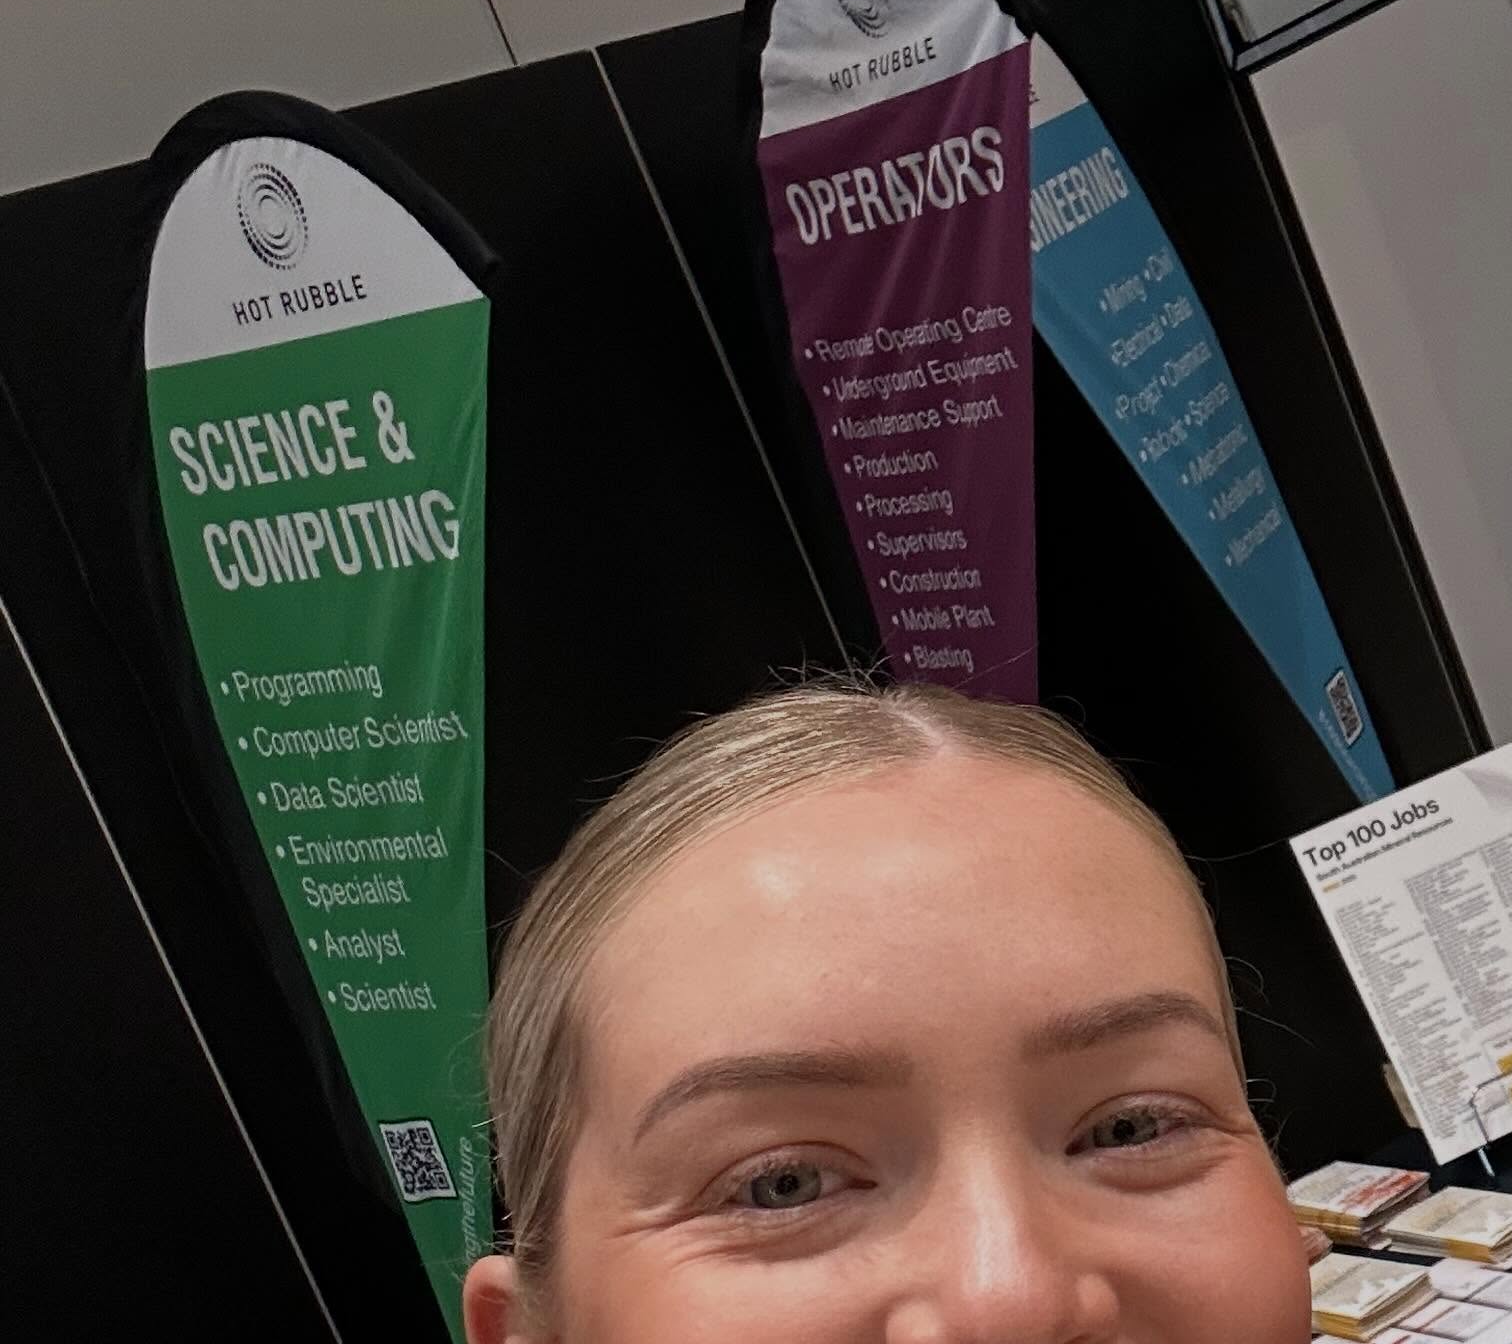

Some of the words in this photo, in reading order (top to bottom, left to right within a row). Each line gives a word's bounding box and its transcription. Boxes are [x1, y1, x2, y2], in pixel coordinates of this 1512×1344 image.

[829, 61, 863, 94] HOT
[867, 36, 938, 80] RUBBLE
[784, 125, 1005, 247] OPERATORS
[232, 295, 274, 326] HOT
[279, 274, 369, 317] RUBBLE
[875, 317, 964, 353] Operating
[962, 304, 1013, 334] Centre
[831, 363, 928, 403] Underground
[927, 346, 1019, 388] Equipment
[839, 406, 942, 442] Maintenance
[942, 394, 1004, 429] Support
[168, 399, 367, 496] SCIENCE
[372, 390, 416, 464] &
[852, 449, 939, 480] Production
[864, 486, 954, 518] Processing
[202, 488, 460, 593] COMPUTING
[875, 526, 968, 560] Supervisors
[888, 563, 982, 595] Construction
[900, 607, 952, 632] Mobile
[952, 604, 996, 629] Plant
[911, 644, 975, 674] Blasting
[231, 659, 384, 707] Programming
[251, 721, 361, 760] Computer
[362, 709, 469, 750] Scientist
[269, 781, 327, 812] Data
[327, 771, 425, 810] Scientist
[287, 826, 449, 867] Environmental
[1302, 840, 1347, 868] Top
[1346, 818, 1387, 848] 100
[1390, 798, 1440, 832] Jobs
[301, 872, 411, 914] Specialist
[323, 928, 407, 965] Analyst
[339, 980, 437, 1013] Scientist
